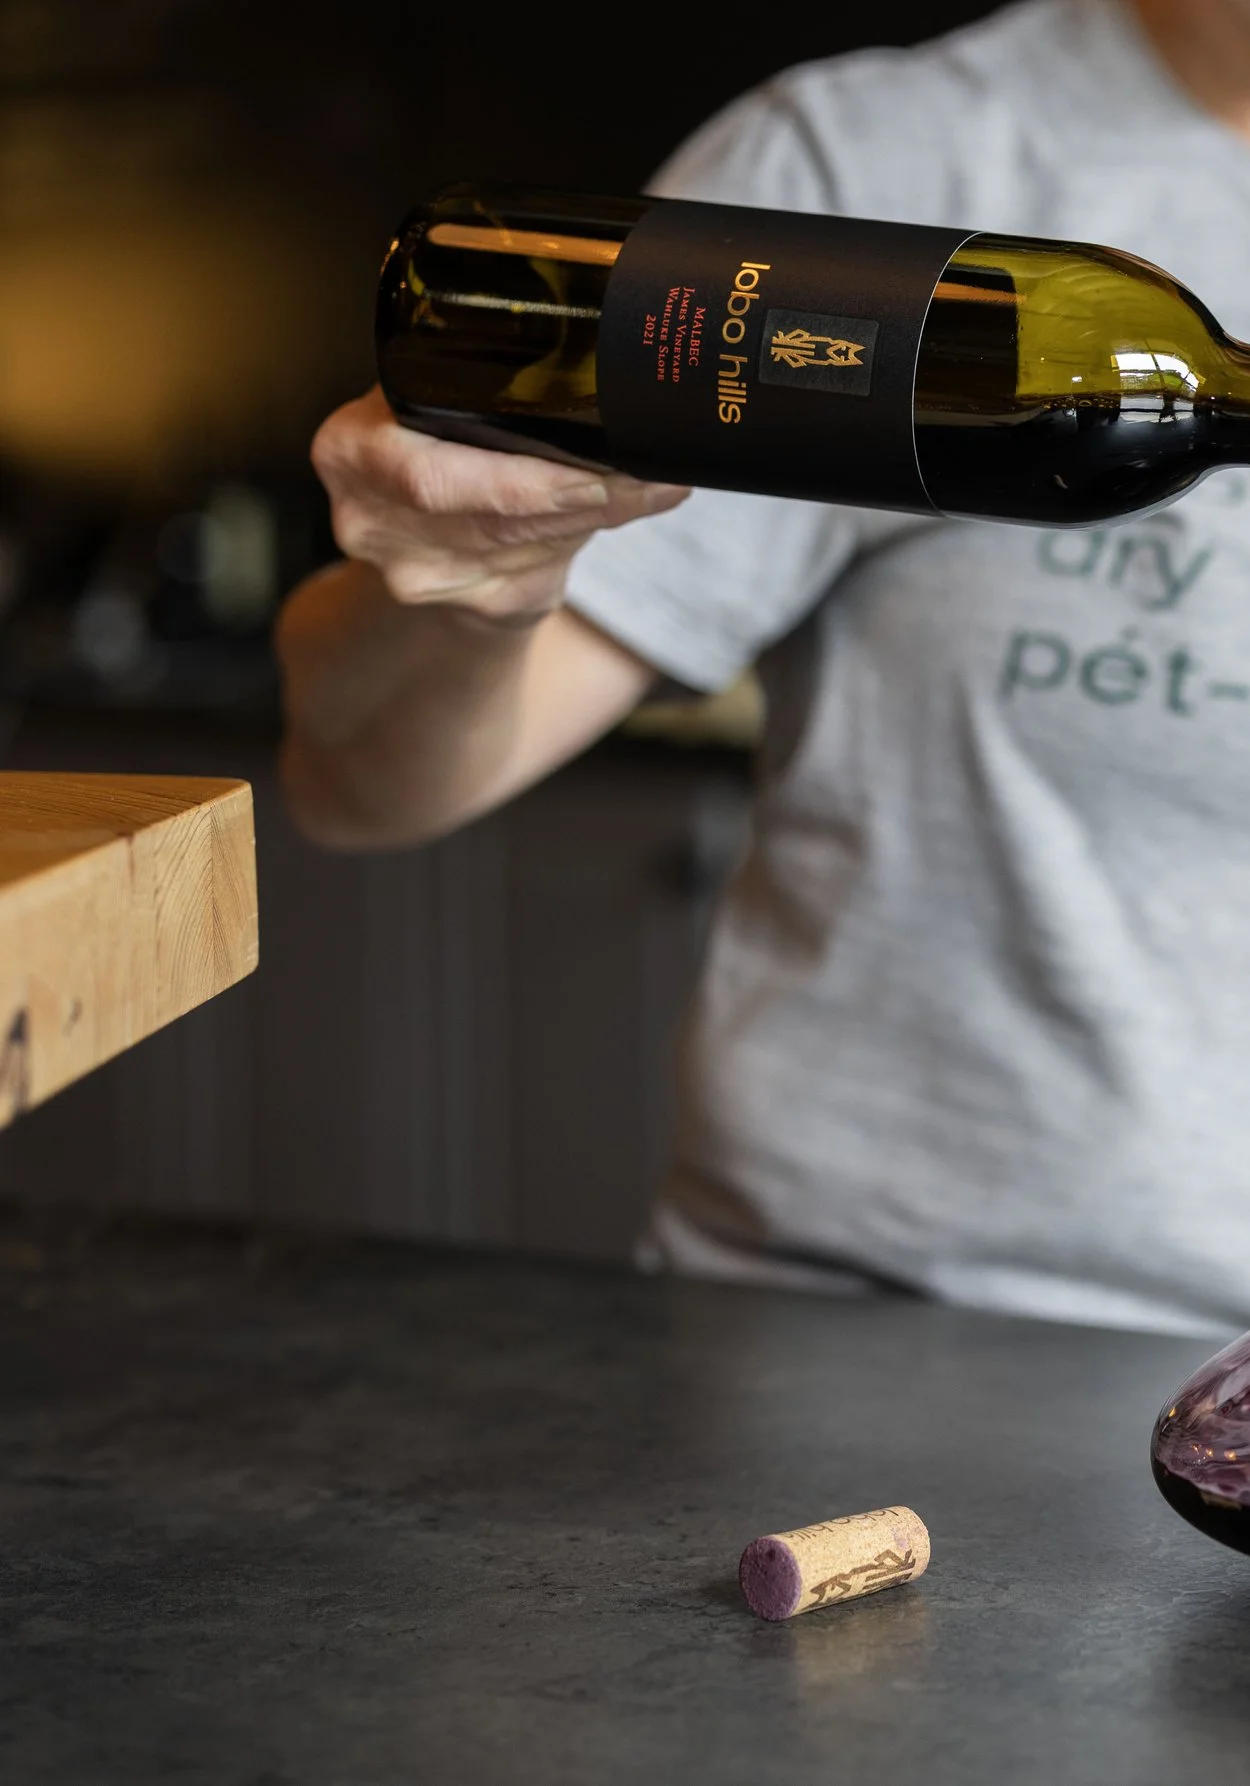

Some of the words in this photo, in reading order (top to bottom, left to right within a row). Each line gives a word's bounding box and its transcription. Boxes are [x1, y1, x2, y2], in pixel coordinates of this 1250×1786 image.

[643, 314, 657, 345] 2021
[660, 286, 681, 341] WAHLUKE
[678, 286, 696, 321] JAMES
[722, 261, 771, 344] lobo
[657, 344, 669, 382] SLOPE
[672, 323, 688, 383] VINEYARD
[688, 306, 706, 367] MALBEC
[717, 353, 748, 424] hills
